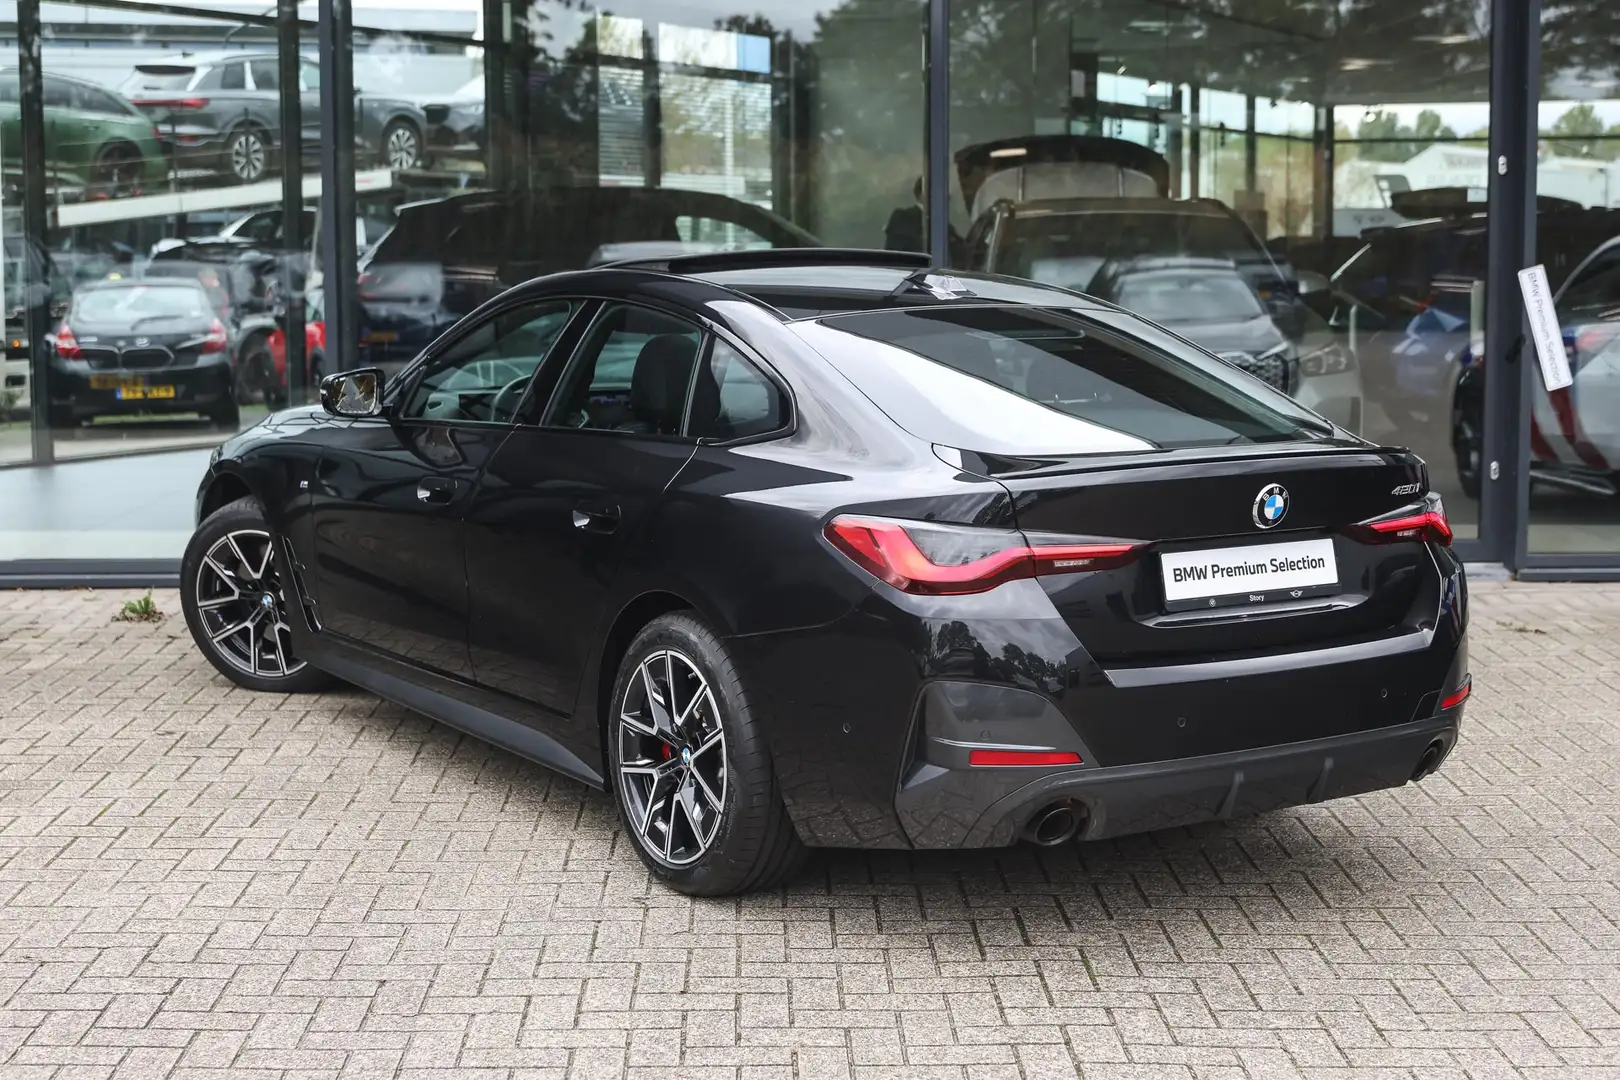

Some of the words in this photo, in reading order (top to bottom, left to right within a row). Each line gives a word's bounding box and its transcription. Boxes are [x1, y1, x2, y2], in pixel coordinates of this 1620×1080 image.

[1527, 272, 1540, 297] BMW
[1534, 299, 1550, 340] Premium
[1545, 342, 1562, 385] Selection
[1391, 482, 1420, 496] 420i
[1173, 565, 1208, 583] BMW
[1211, 561, 1268, 579] Premium
[1269, 555, 1326, 573] Selection
[1249, 594, 1265, 602] Story
